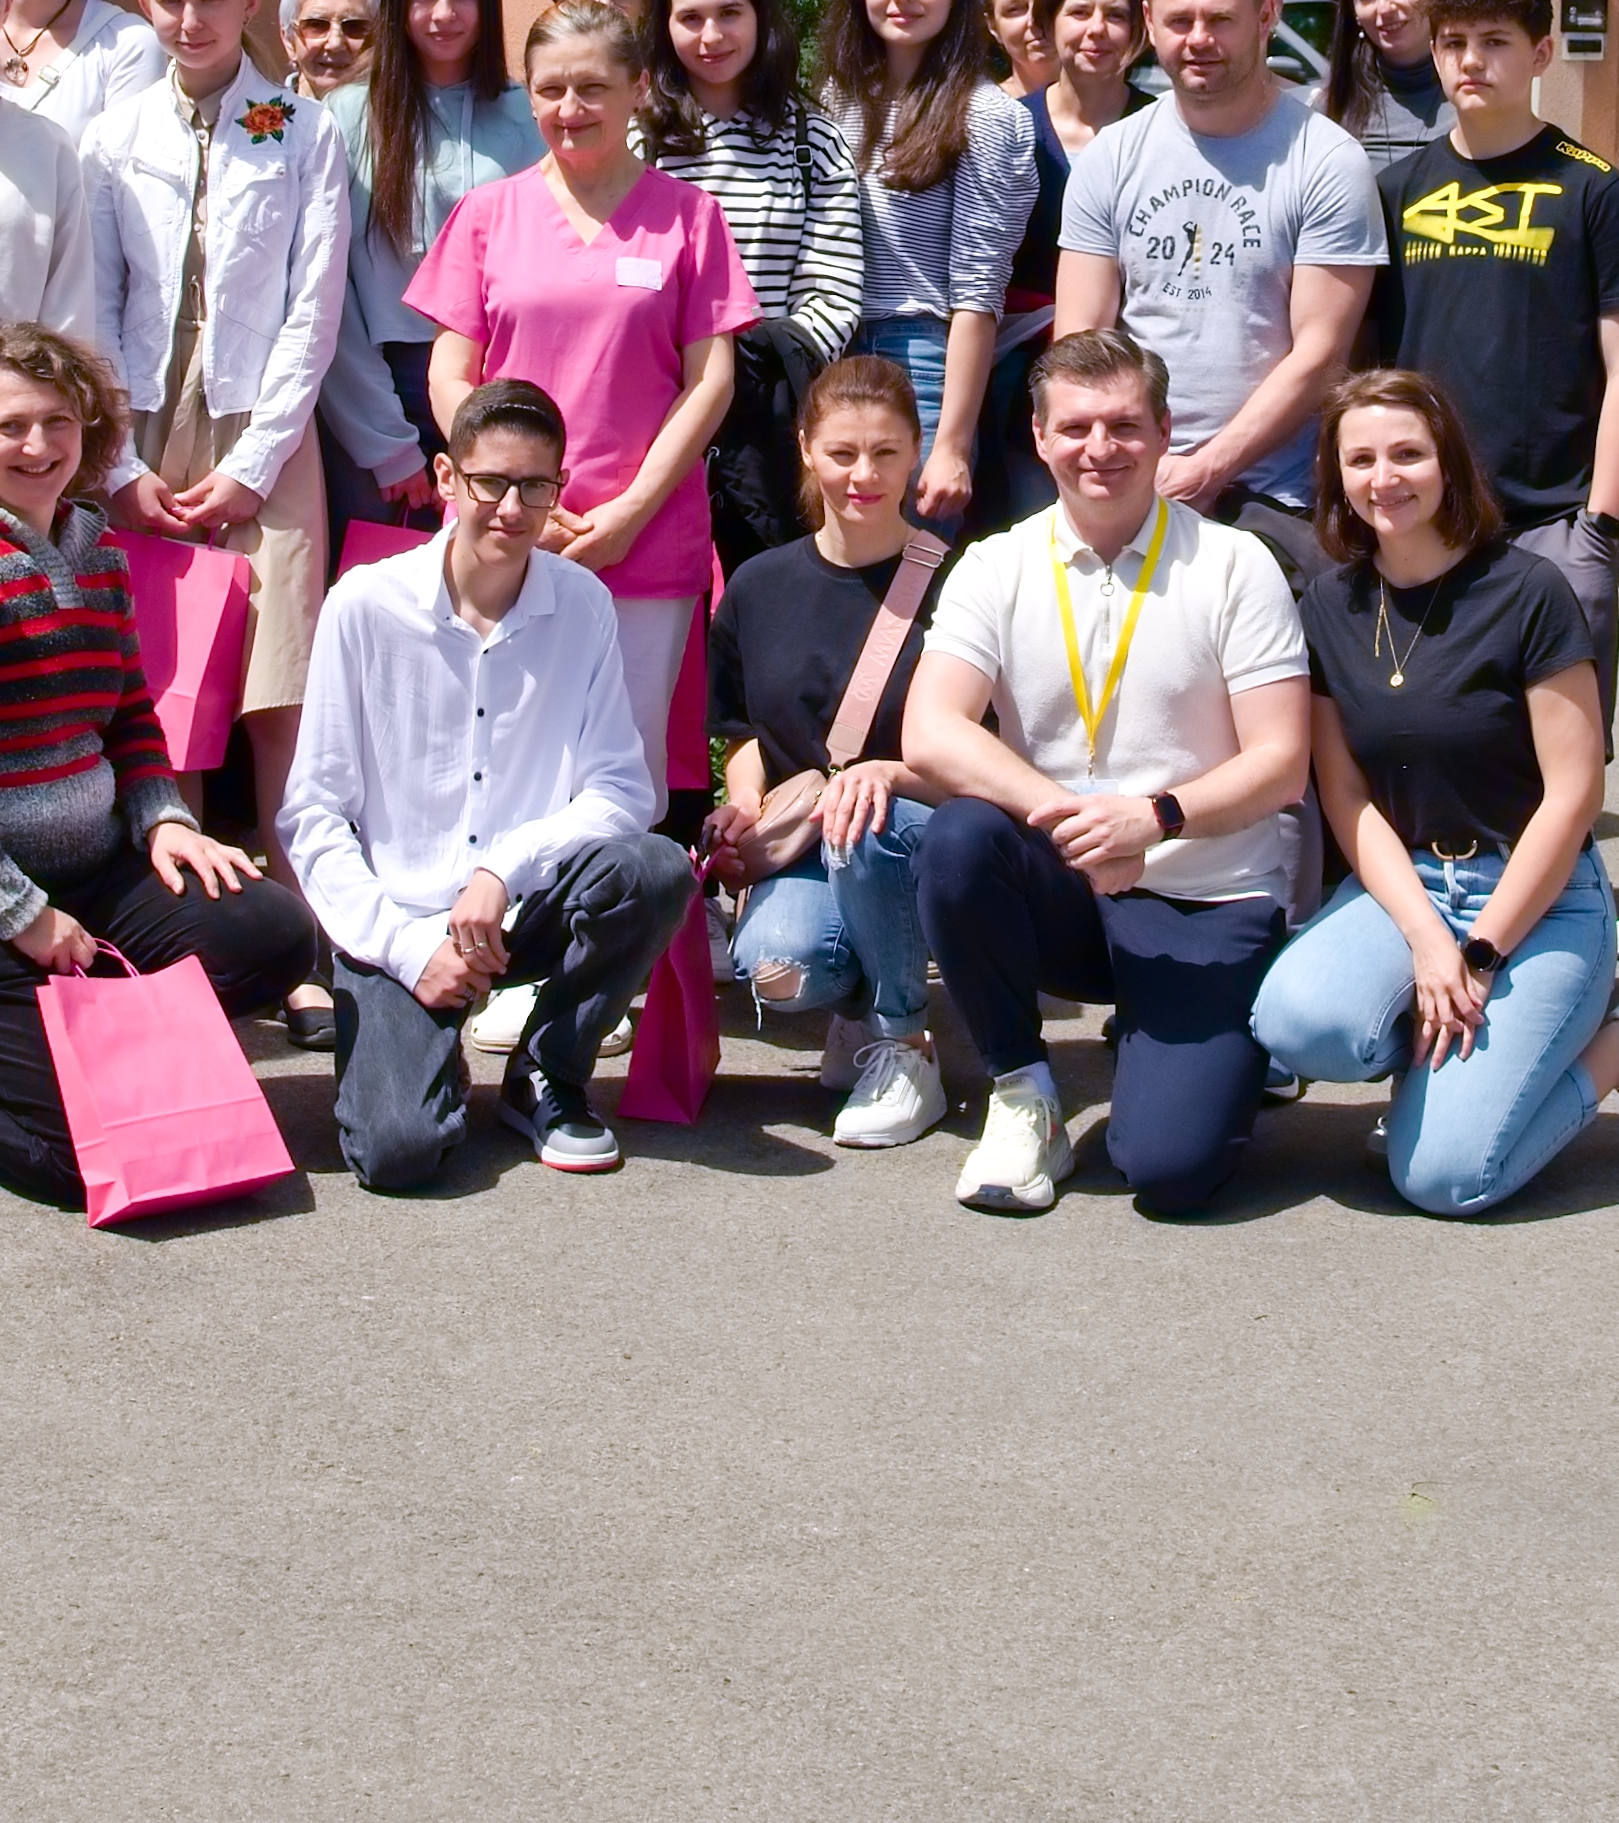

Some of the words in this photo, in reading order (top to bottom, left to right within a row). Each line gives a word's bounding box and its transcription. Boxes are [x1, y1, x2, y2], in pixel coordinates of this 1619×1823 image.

[1128, 178, 1233, 237] CHAMPION
[1229, 195, 1262, 248] RACE
[1146, 235, 1176, 261] 20
[1209, 241, 1236, 267] 24
[1162, 282, 1182, 298] EST
[1187, 286, 1213, 300] 2014
